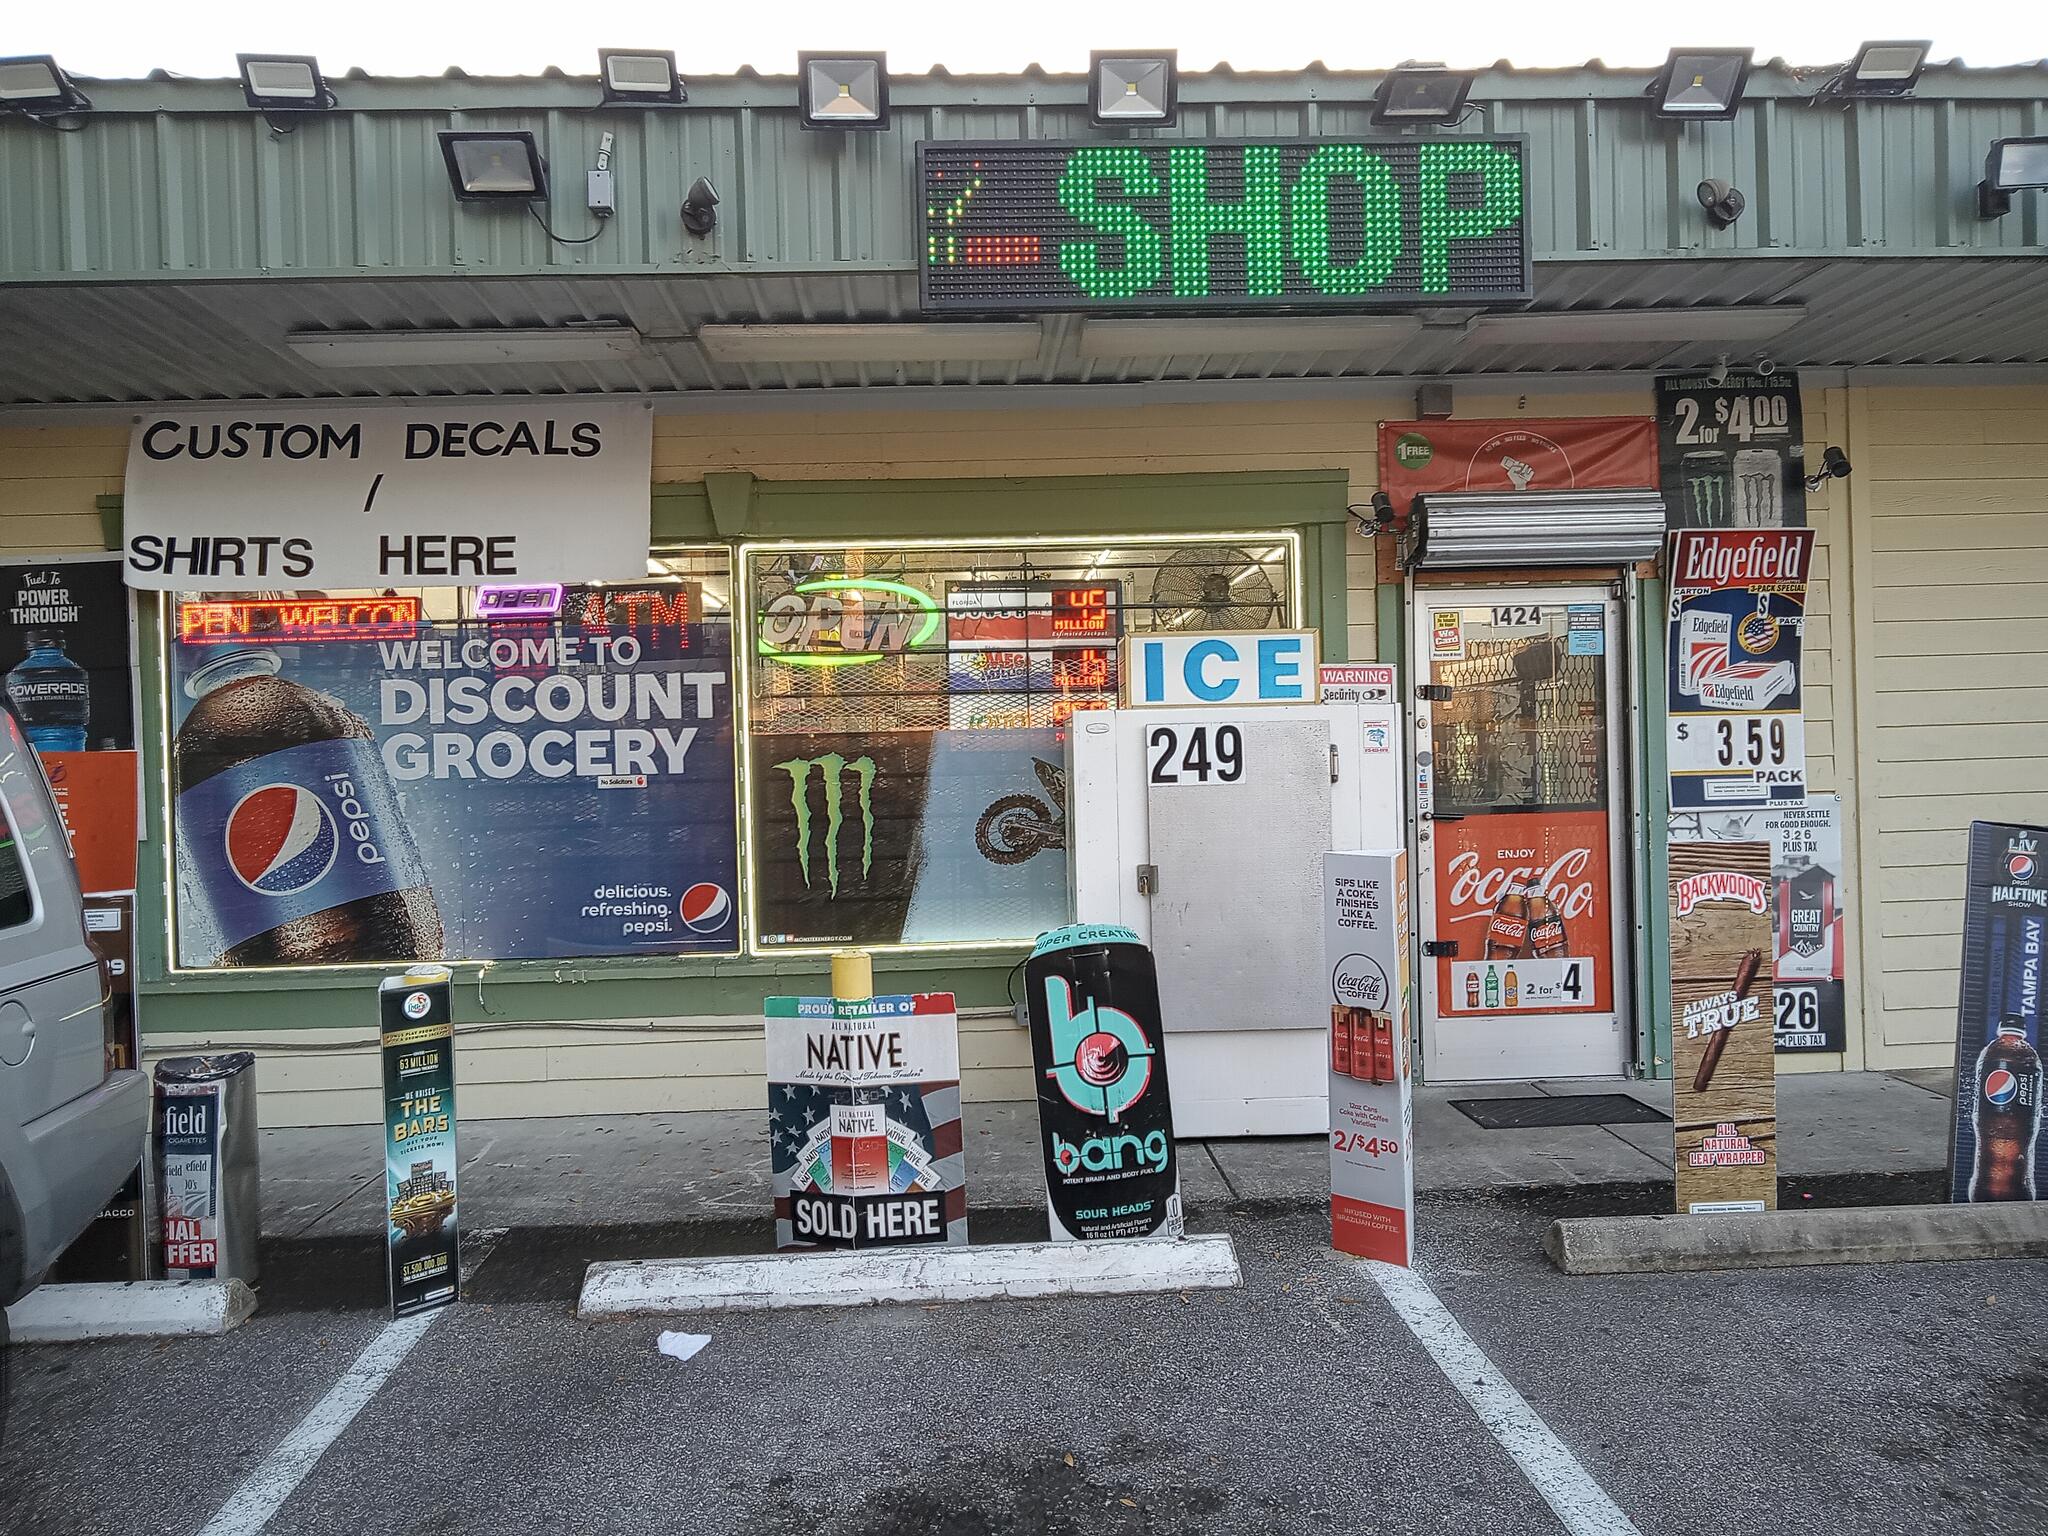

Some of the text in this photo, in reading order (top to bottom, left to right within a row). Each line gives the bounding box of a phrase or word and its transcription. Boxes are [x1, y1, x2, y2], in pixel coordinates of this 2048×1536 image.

[1059, 144, 1521, 298] SHOP
[1675, 398, 1700, 444] 2
[1699, 425, 1720, 444] for
[141, 421, 602, 460] CUSTOM DECALS
[1407, 446, 1430, 455] FREE
[364, 473, 384, 512] /
[128, 535, 517, 577] SHIRTS HERE
[1684, 536, 1803, 586] Edgefield
[23, 571, 61, 588] Fuel To
[482, 588, 557, 609] OPEN
[1674, 588, 1710, 596] CARTON
[1778, 584, 1805, 592] SPECIAL
[10, 606, 78, 624] THROUGH
[1491, 606, 1542, 626] 1424
[1671, 595, 1767, 619] $ $
[578, 591, 689, 651] ATM
[763, 593, 920, 651] OPEN
[1054, 620, 1105, 631] MILLION
[1693, 617, 1728, 634] Edgefield
[378, 635, 642, 670] WELCOME TO
[1144, 638, 1302, 702] ICE
[1323, 670, 1389, 683] WARNING
[9, 683, 86, 696] POWERADE
[1323, 688, 1360, 702] Security
[1715, 683, 1754, 701] Edgefield
[380, 672, 726, 726] DISCOUNT
[1677, 718, 1785, 766] $ 3.59
[381, 727, 699, 781] GROCERY
[1150, 724, 1243, 784] 249
[1756, 770, 1803, 783] PACK
[325, 772, 386, 864] pepsi
[1783, 810, 1830, 819] NEVER SETTLE
[1765, 820, 1831, 829] FOR GOOD ENOUGH.
[1497, 849, 1535, 859] ENJOY
[1783, 841, 1818, 852] PLUS TAX
[594, 884, 672, 899] delicious.
[1335, 877, 1379, 889] SIPS LIKE
[1679, 873, 1763, 911] BACKWOODS
[1337, 888, 1375, 901] A COKE,
[1992, 885, 2048, 908] HALFTIME
[581, 902, 673, 918] refreshing.
[1335, 898, 1379, 910] FINISHES
[1342, 908, 1372, 920] LIKE A
[1791, 909, 1822, 924] GREAT
[623, 918, 673, 936] pepsi.
[1338, 918, 1378, 930] COFFEE.
[1793, 923, 1820, 933] COUNTRY
[1034, 933, 1071, 951] SUPER
[2022, 919, 2041, 1017] TAMPA BAY
[1338, 972, 1382, 993] Coca-Cola
[1526, 983, 1535, 995] 2
[1539, 986, 1553, 995] for
[1346, 990, 1378, 1001] COFFEE
[1683, 990, 1738, 1017] ALWAYS
[797, 1001, 916, 1016] PROUD RETAILER OF
[1774, 991, 1817, 1029] 26
[831, 1021, 876, 1031] ALL NATURAL
[1682, 996, 1760, 1040] TRUE
[1788, 1035, 1822, 1046] PLUS TAX
[410, 1053, 439, 1068] MILLION
[806, 1032, 903, 1071] NATIVE
[795, 1070, 815, 1080] Made
[815, 1072, 824, 1082] by
[863, 1071, 891, 1080] Tobacco
[892, 1069, 921, 1078] Traders
[2019, 1073, 2029, 1106] pepsi
[401, 1095, 442, 1119] THE
[393, 1114, 449, 1142] BARS
[1717, 1123, 1737, 1136] ALL
[1704, 1137, 1750, 1150] NATURAL
[1052, 1130, 1169, 1177] bang
[1690, 1151, 1764, 1165] LEAF WRAPPER
[1063, 1168, 1155, 1185] POTENT BRAIN AND BODY FUEL
[796, 1198, 941, 1240] SOLD HERE
[1075, 1208, 1109, 1220] SOUR
[1112, 1201, 1152, 1218] HEADS
[1372, 1213, 1392, 1223] WITH
[1111, 1220, 1134, 1230] Artificial
[1134, 1217, 1152, 1226] Flavors
